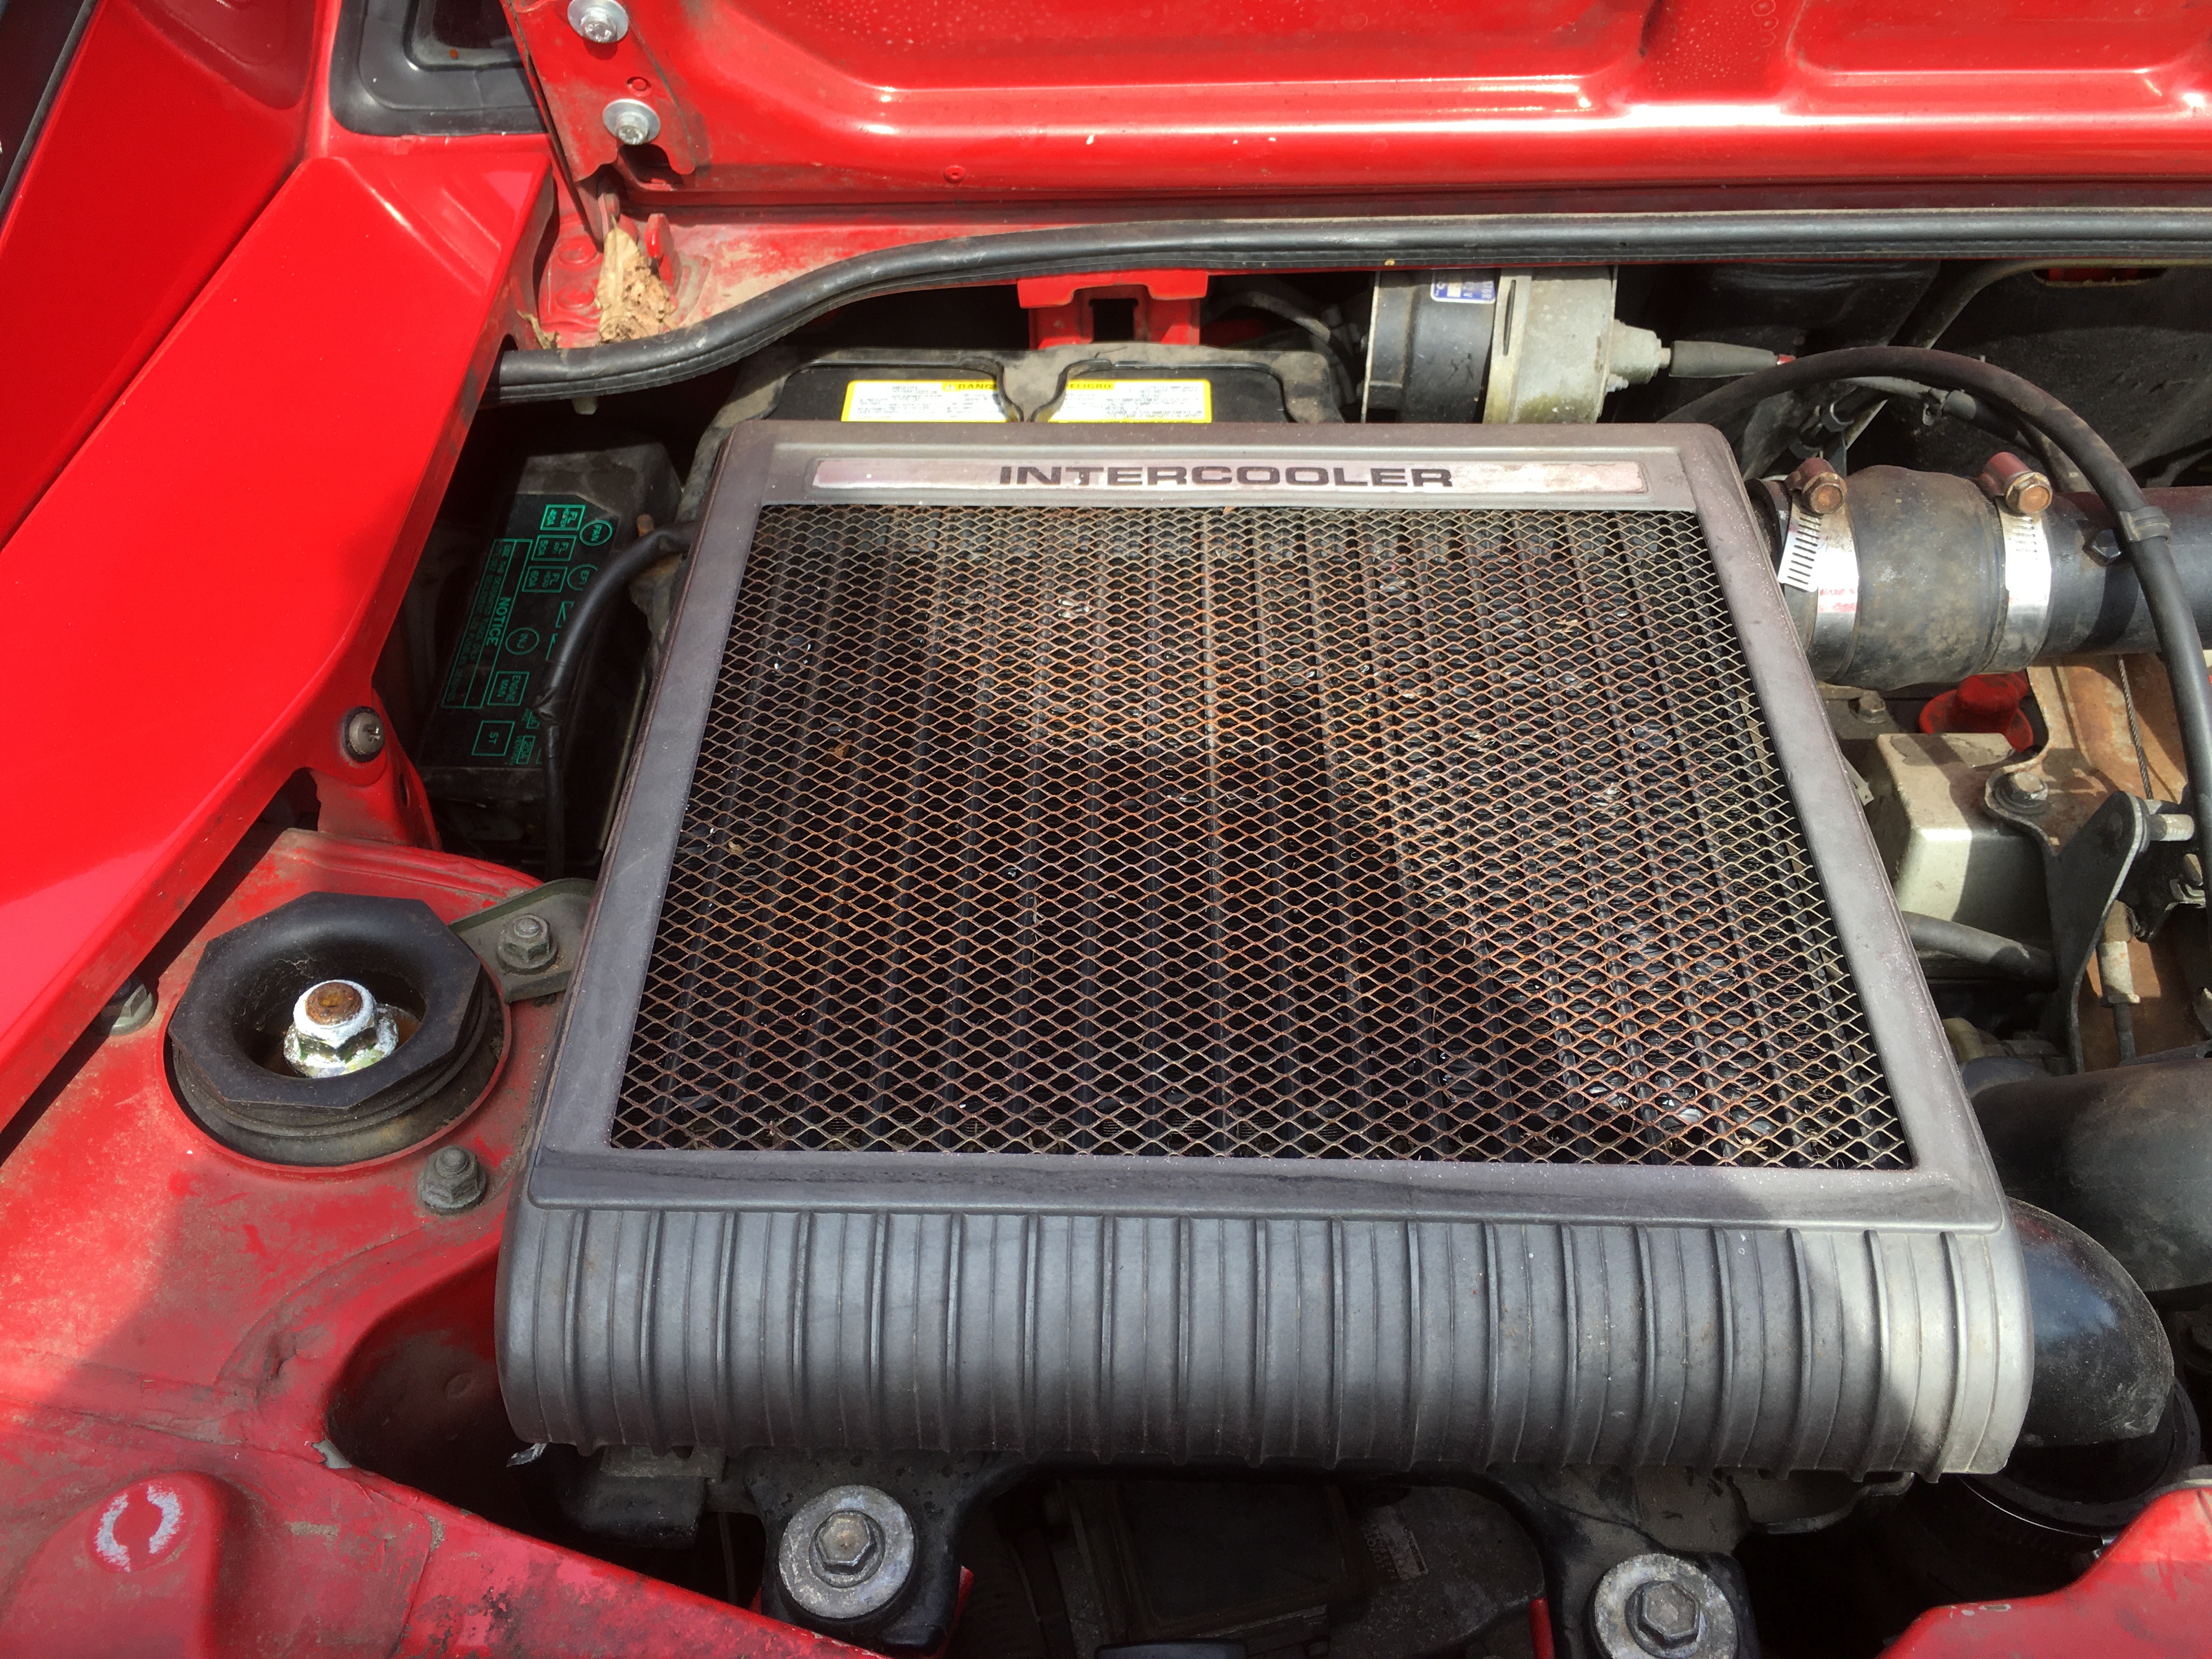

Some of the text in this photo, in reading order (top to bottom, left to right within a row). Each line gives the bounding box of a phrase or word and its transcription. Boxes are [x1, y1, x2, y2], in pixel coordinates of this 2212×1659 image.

[1000, 466, 1453, 488] INTERCOOLER
[567, 511, 578, 524] FL
[591, 524, 603, 541] FAN
[537, 540, 549, 556] 50A
[558, 541, 569, 555] FL
[527, 570, 539, 588] 60A
[549, 572, 560, 585] FL
[486, 597, 511, 646] NOTICE
[516, 633, 529, 648] INJ
[488, 732, 499, 745] ST
